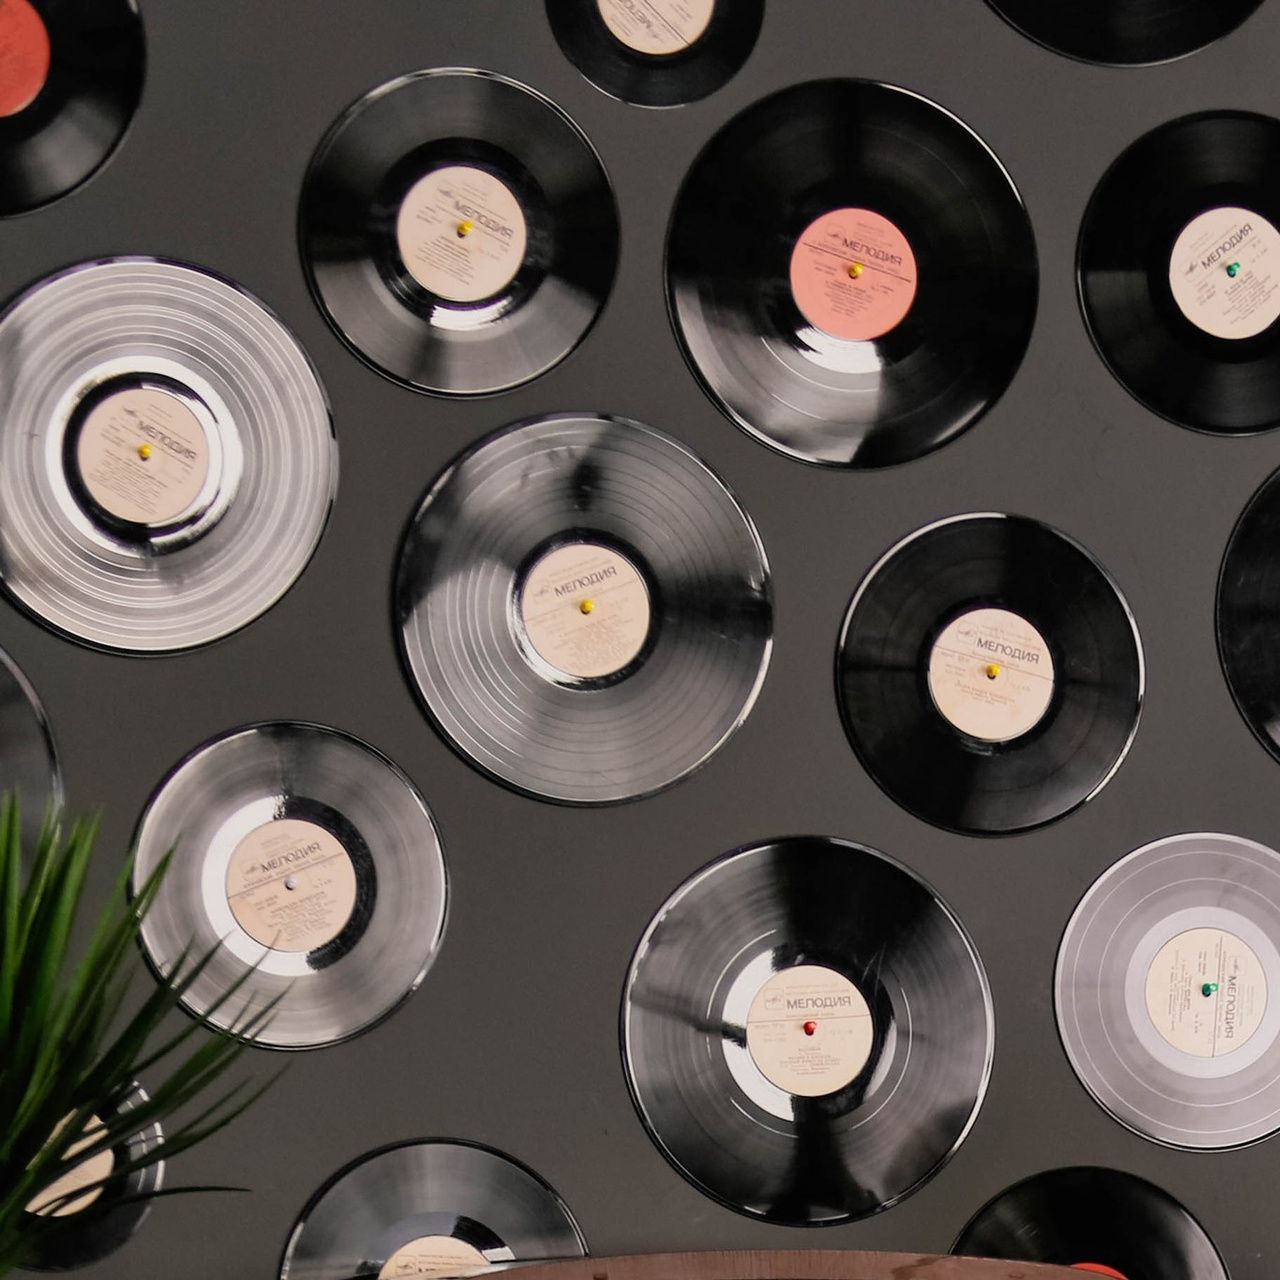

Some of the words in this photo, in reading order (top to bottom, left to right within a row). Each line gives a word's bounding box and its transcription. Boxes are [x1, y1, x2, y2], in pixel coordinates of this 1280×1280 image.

[1201, 223, 1254, 269] МЕЛОДИЯ
[554, 566, 617, 597] МЕЛОДИЯ
[977, 636, 1040, 664] МЕЛОДИЯ
[786, 996, 851, 1010] МЕЛОДИЯ
[1226, 975, 1237, 1039] МЕЛОДИЯ
